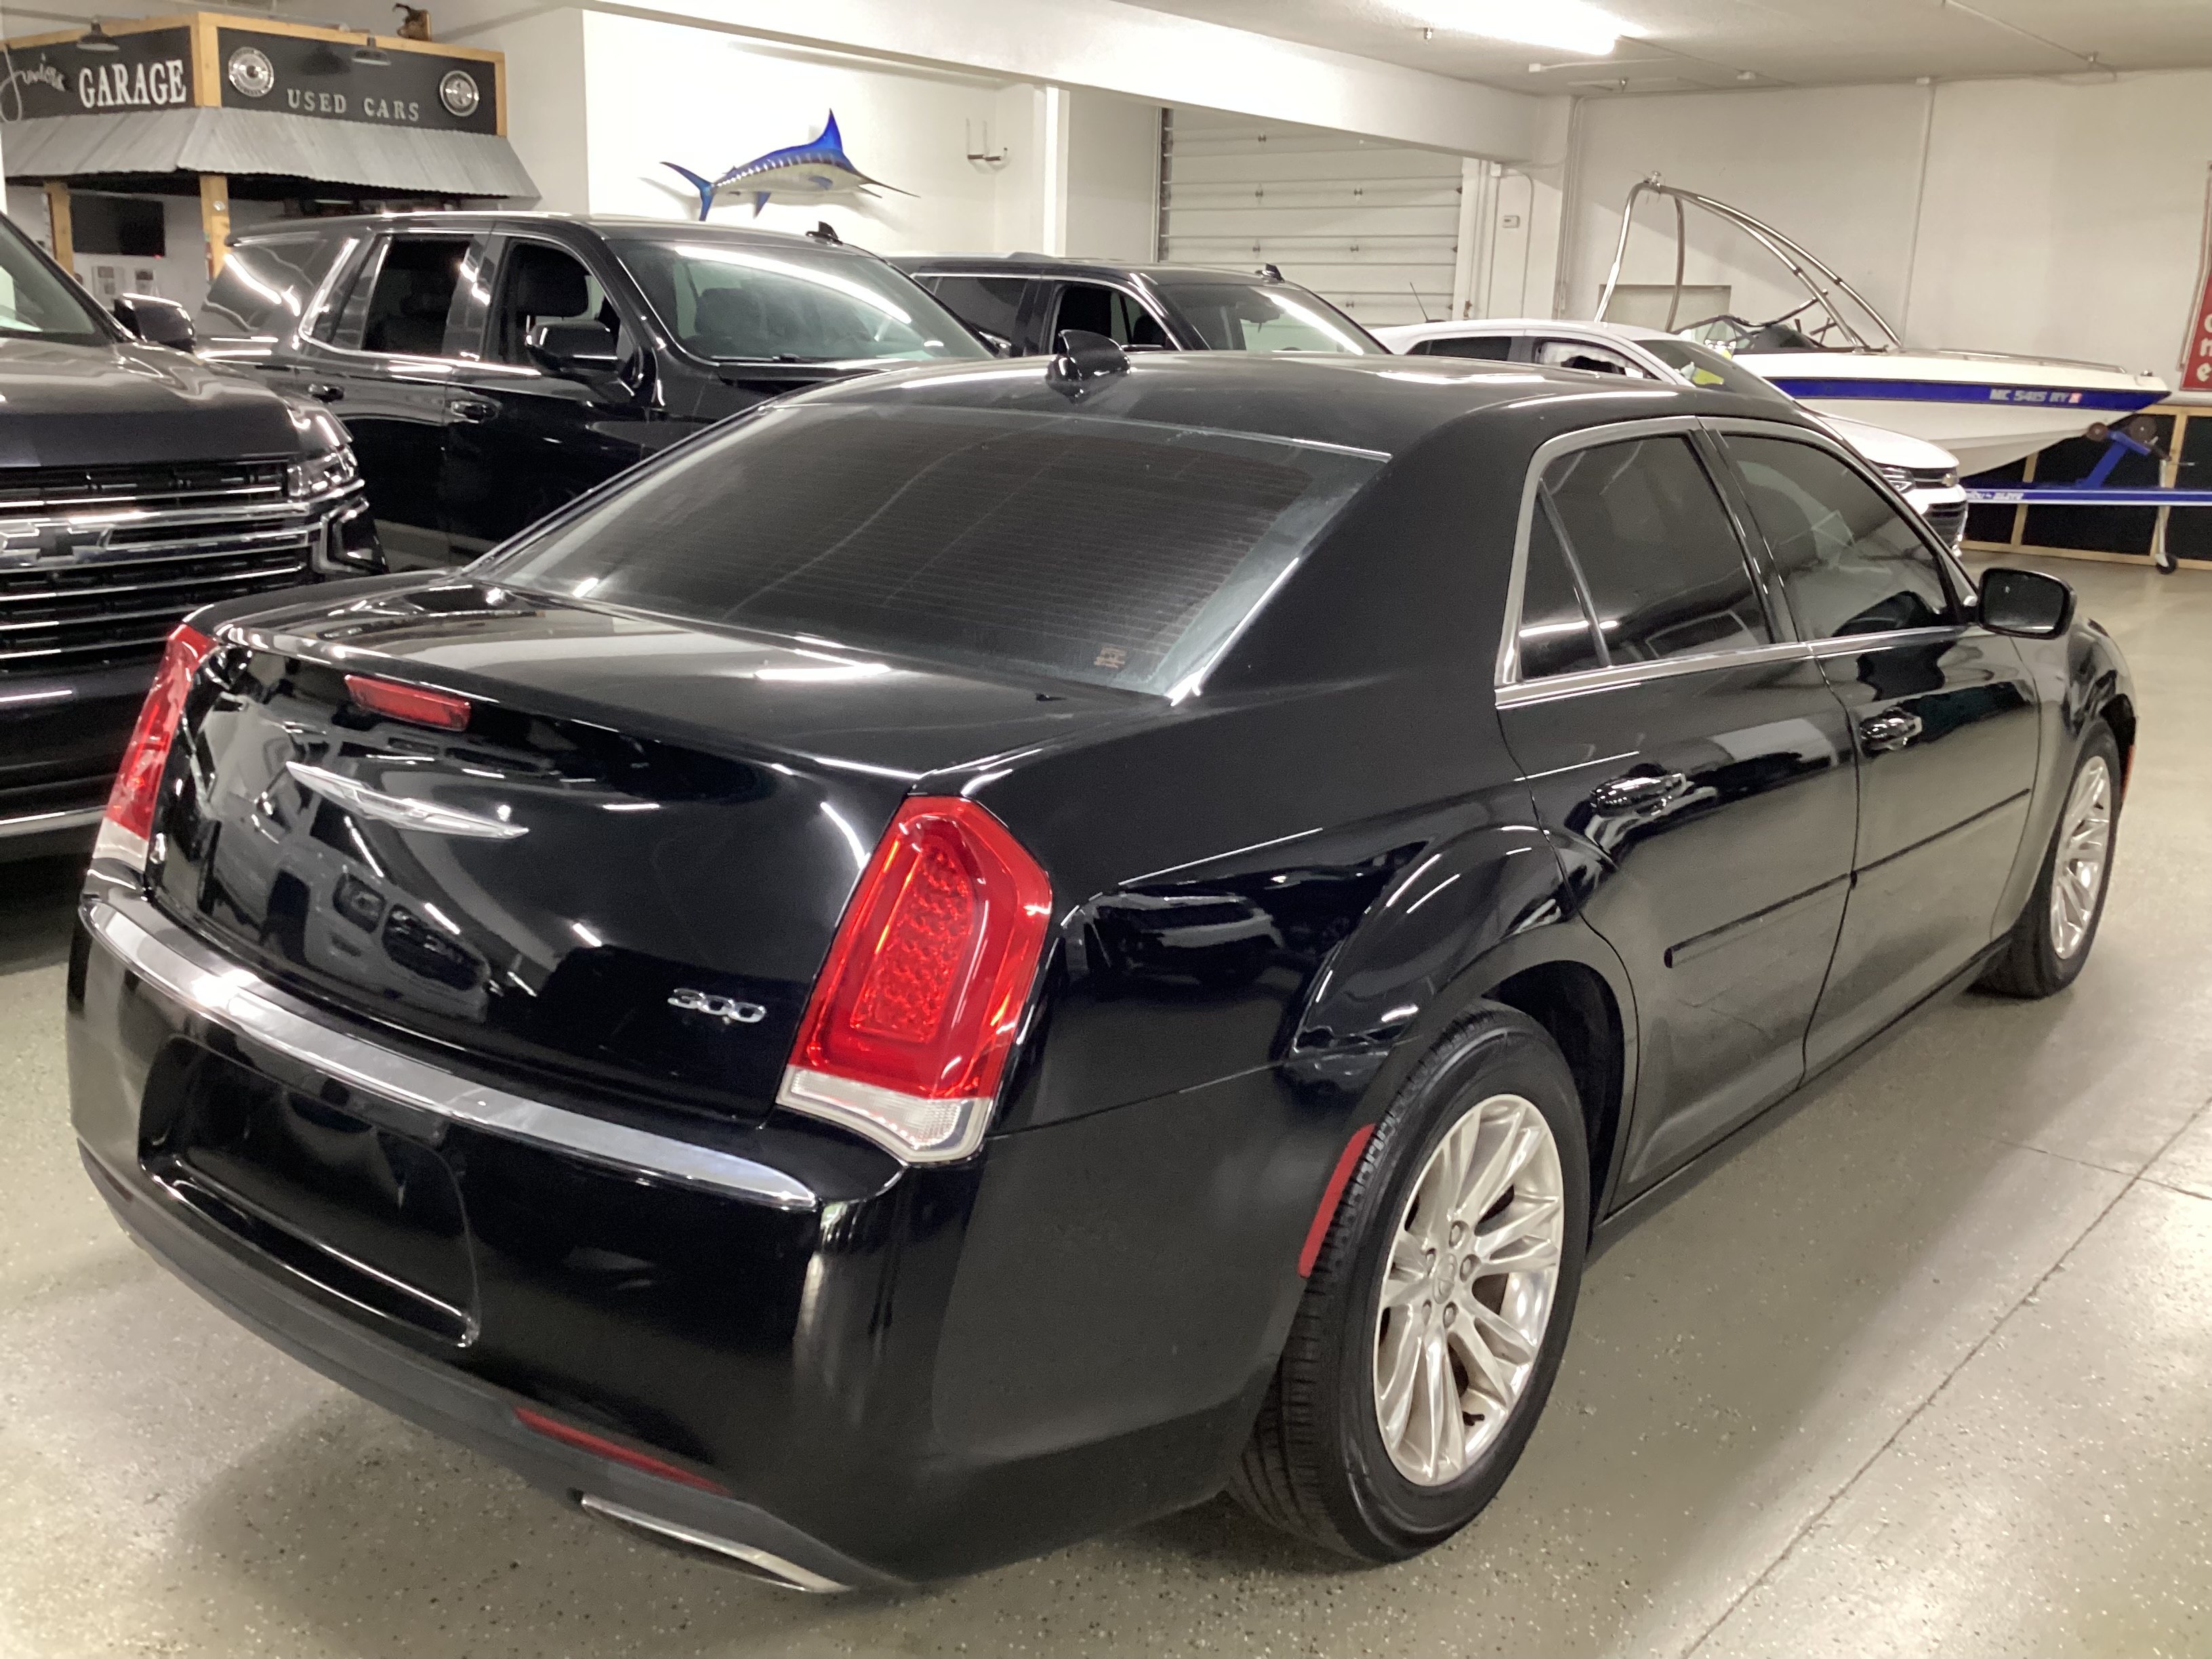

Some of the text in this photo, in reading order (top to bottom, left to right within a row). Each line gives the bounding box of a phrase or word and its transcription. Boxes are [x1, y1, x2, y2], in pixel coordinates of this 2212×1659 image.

[79, 59, 187, 108] GARAGE
[287, 88, 419, 122] USED CARS
[667, 987, 766, 1024] 300
